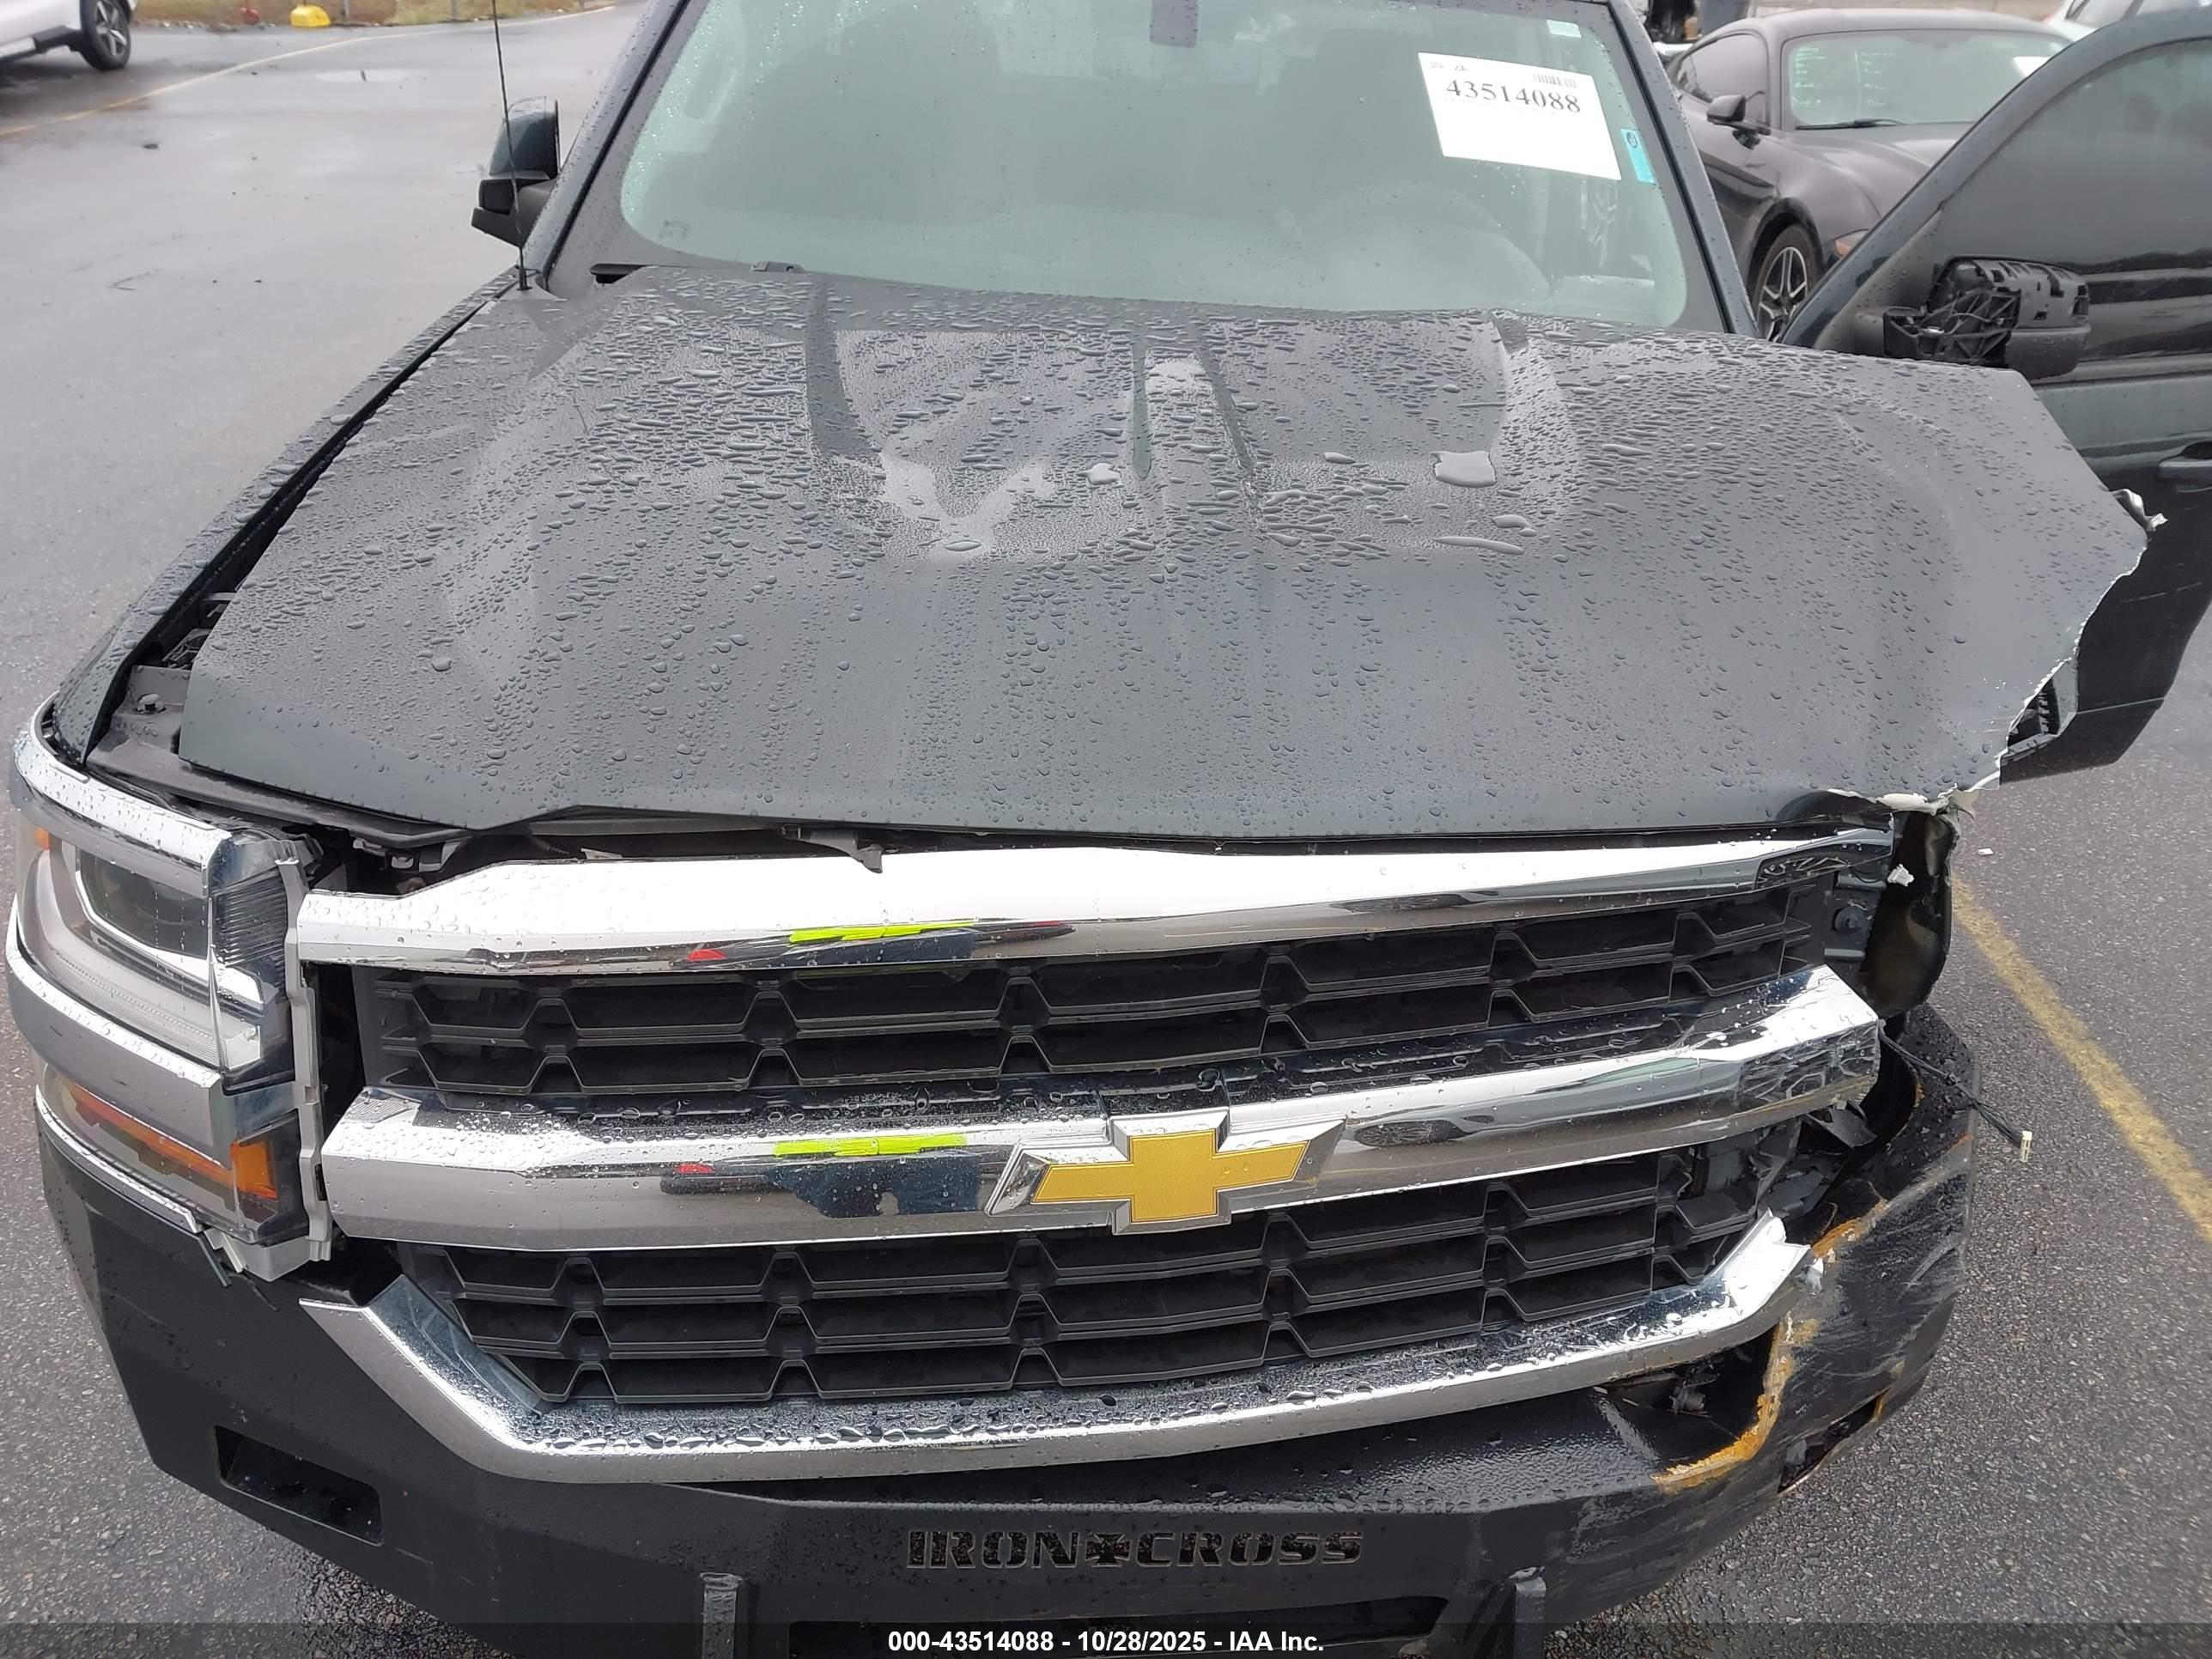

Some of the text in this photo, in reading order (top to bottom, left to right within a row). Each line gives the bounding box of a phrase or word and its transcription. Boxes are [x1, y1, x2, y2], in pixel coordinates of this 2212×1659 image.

[1445, 79, 1582, 113] 43514088
[907, 1530, 1363, 1569] IRON CROSS
